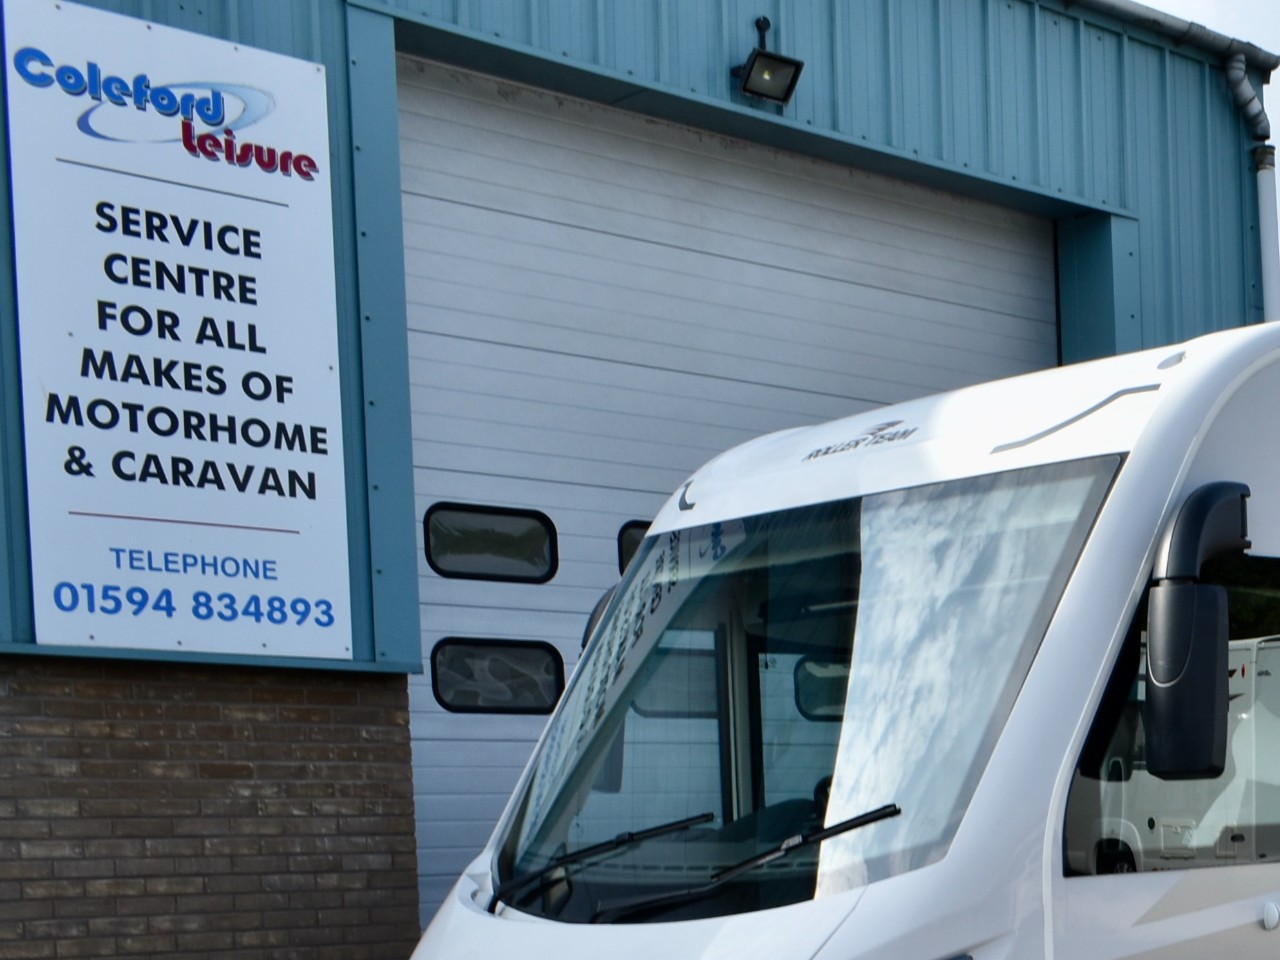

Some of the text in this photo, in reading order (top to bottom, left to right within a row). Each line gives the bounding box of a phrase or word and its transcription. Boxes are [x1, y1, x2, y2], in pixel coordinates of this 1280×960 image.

[13, 46, 225, 126] Coleford
[181, 119, 320, 181] Leisure
[95, 201, 262, 260] SERVICE
[104, 253, 258, 306] CENTRE
[97, 300, 267, 354] FOR ALL
[80, 347, 294, 404] MAKES OF
[45, 393, 329, 455] MOTORHOME
[866, 427, 919, 447] TEAM
[63, 445, 317, 501] & CARAVAN
[109, 547, 278, 581] TELEPHONE
[53, 581, 335, 628] 01594 834893
